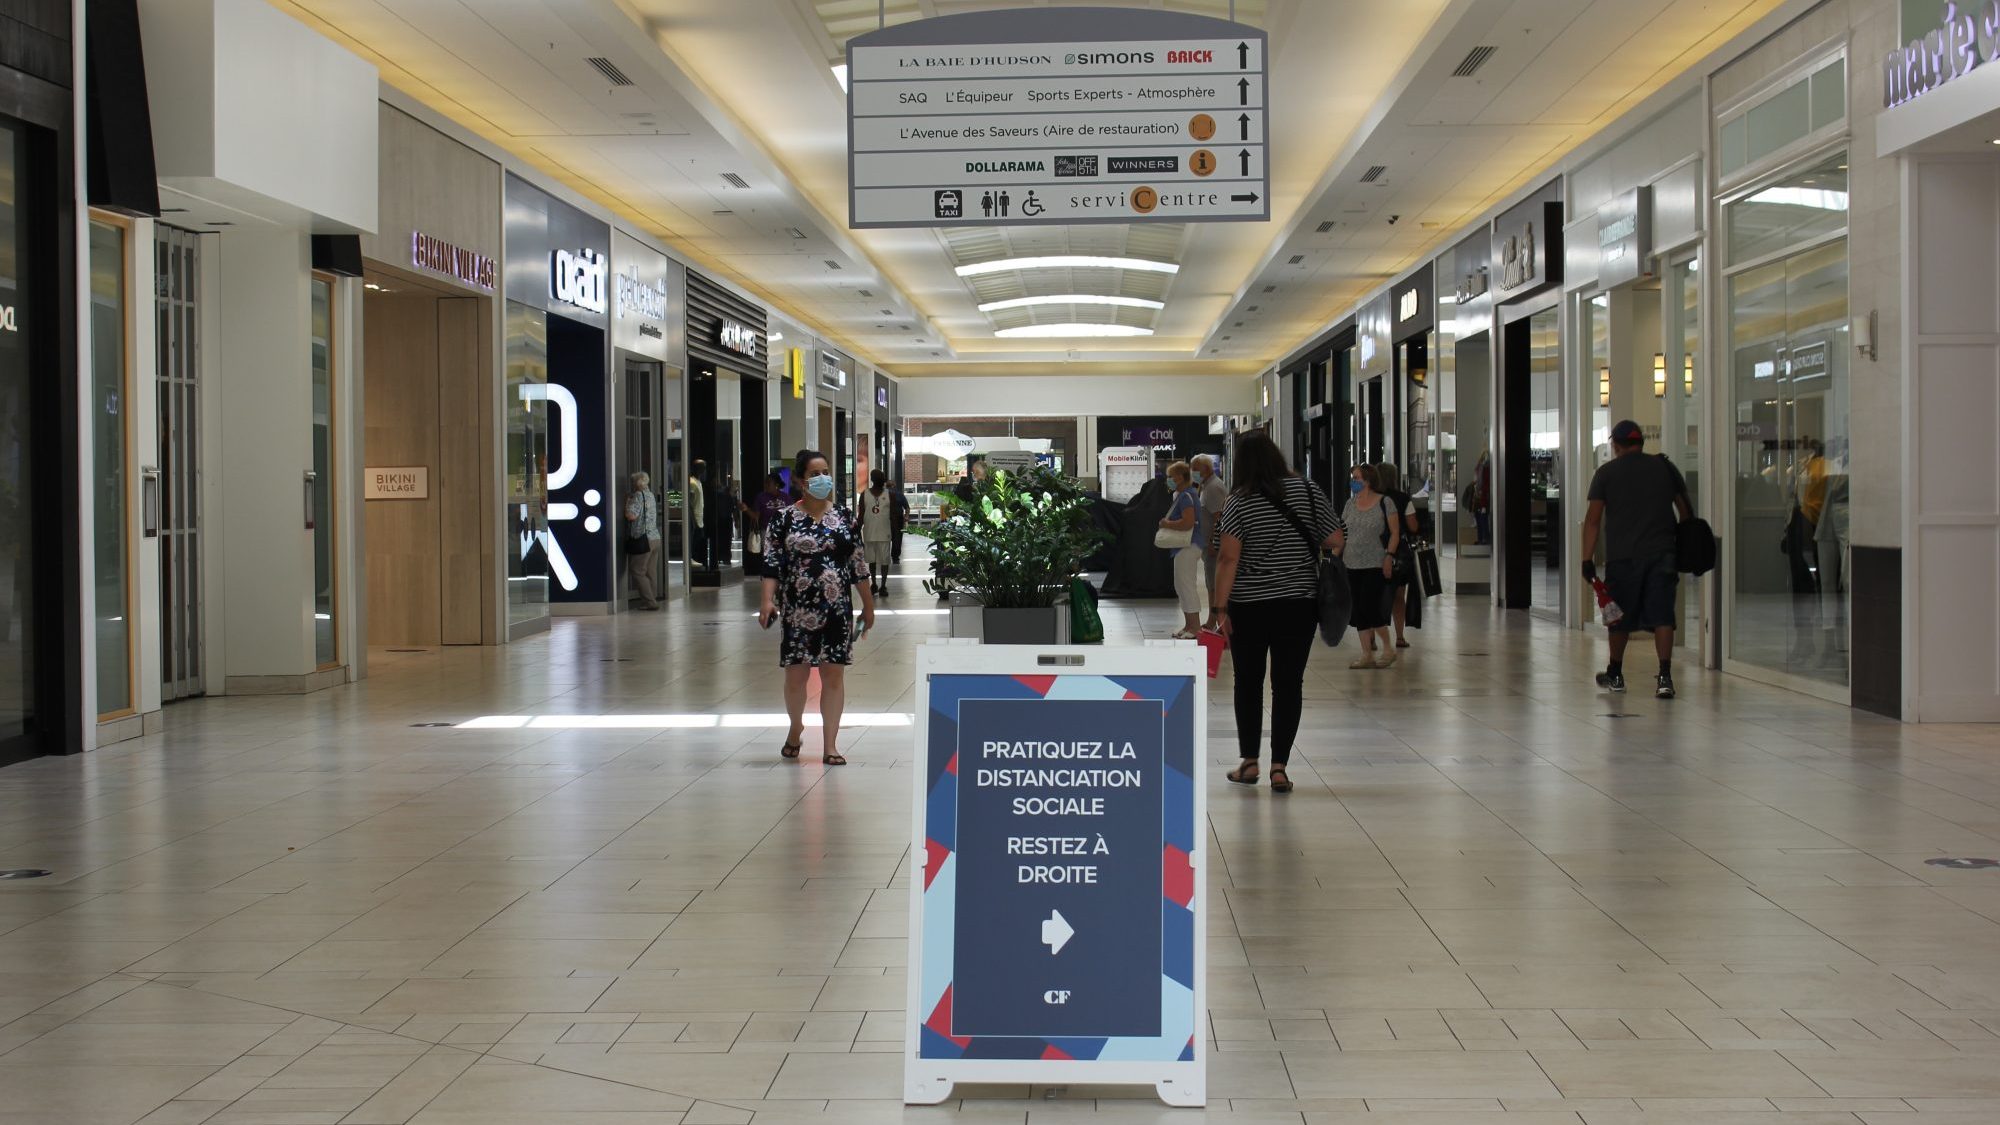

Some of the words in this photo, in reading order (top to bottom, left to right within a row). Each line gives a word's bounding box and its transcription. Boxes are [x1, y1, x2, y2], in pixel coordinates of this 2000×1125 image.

[899, 58, 920, 68] LA
[926, 57, 964, 67] BAIE
[970, 55, 1051, 66] D'HUDSON
[1077, 51, 1155, 65] simons
[1167, 50, 1213, 64] BRICK
[899, 92, 928, 104] SAQ
[946, 89, 1014, 104] L'Équipeur
[1027, 90, 1070, 103] Sports
[1074, 88, 1123, 102] Experts
[1137, 86, 1216, 100] Atmosphère
[965, 127, 986, 138] des
[989, 127, 1039, 137] Saveurs
[1043, 124, 1074, 137] (Aire
[1079, 124, 1095, 136] de
[1098, 122, 1180, 136] restauration)
[965, 161, 1045, 173] DOLLARAMA
[1078, 156, 1096, 166] OFF
[1112, 160, 1174, 169] WINNERS
[1078, 165, 1097, 175] 5TH
[413, 231, 453, 275] BIKINI
[455, 246, 497, 290] VILLAGE
[376, 474, 416, 485] BIKINI
[376, 485, 416, 493] VILLAGE
[871, 505, 880, 515] 6
[983, 741, 1102, 759] PRATIQUEZ
[1109, 741, 1136, 759] LA
[977, 769, 1141, 787] DISTANCIATION
[1012, 797, 1104, 815] SOCIALE
[1007, 836, 1087, 854] RESTEZ
[1093, 833, 1109, 855] À
[1018, 865, 1097, 883] DROITE
[1044, 990, 1071, 1004] CF
